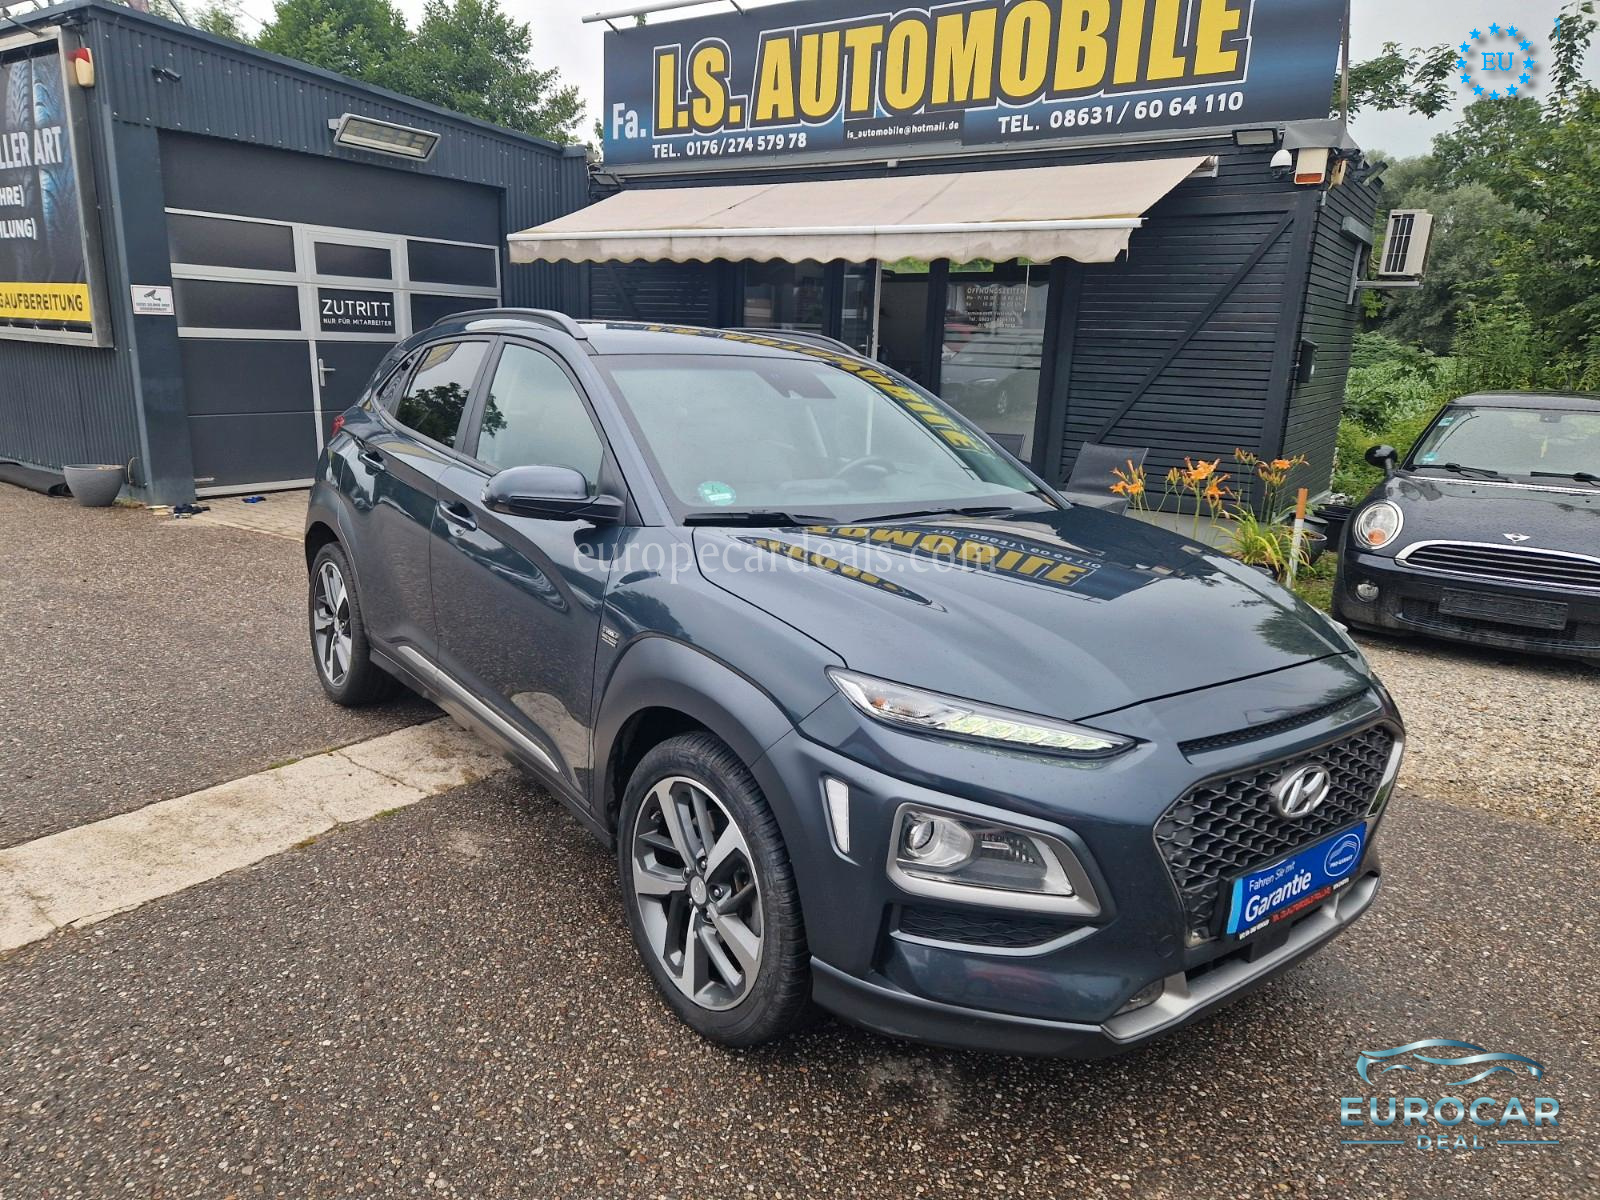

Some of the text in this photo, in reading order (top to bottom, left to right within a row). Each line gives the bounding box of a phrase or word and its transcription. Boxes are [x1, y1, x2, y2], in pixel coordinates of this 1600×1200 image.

[657, 0, 1241, 130] I.S. AUTOMOBILE
[612, 103, 647, 140] Fa.
[998, 115, 1040, 134] TEL.
[1168, 95, 1197, 116] 64
[1204, 91, 1244, 113] 110
[34, 126, 62, 165] ART
[652, 143, 681, 158] TEL.
[757, 134, 784, 150] 579
[789, 132, 807, 148] 78
[322, 299, 391, 317] ZUTRITT
[323, 317, 392, 327] NUR FÜR MITARBEITER
[1245, 868, 1312, 922] Garantie
[1249, 873, 1275, 892] Fahren
